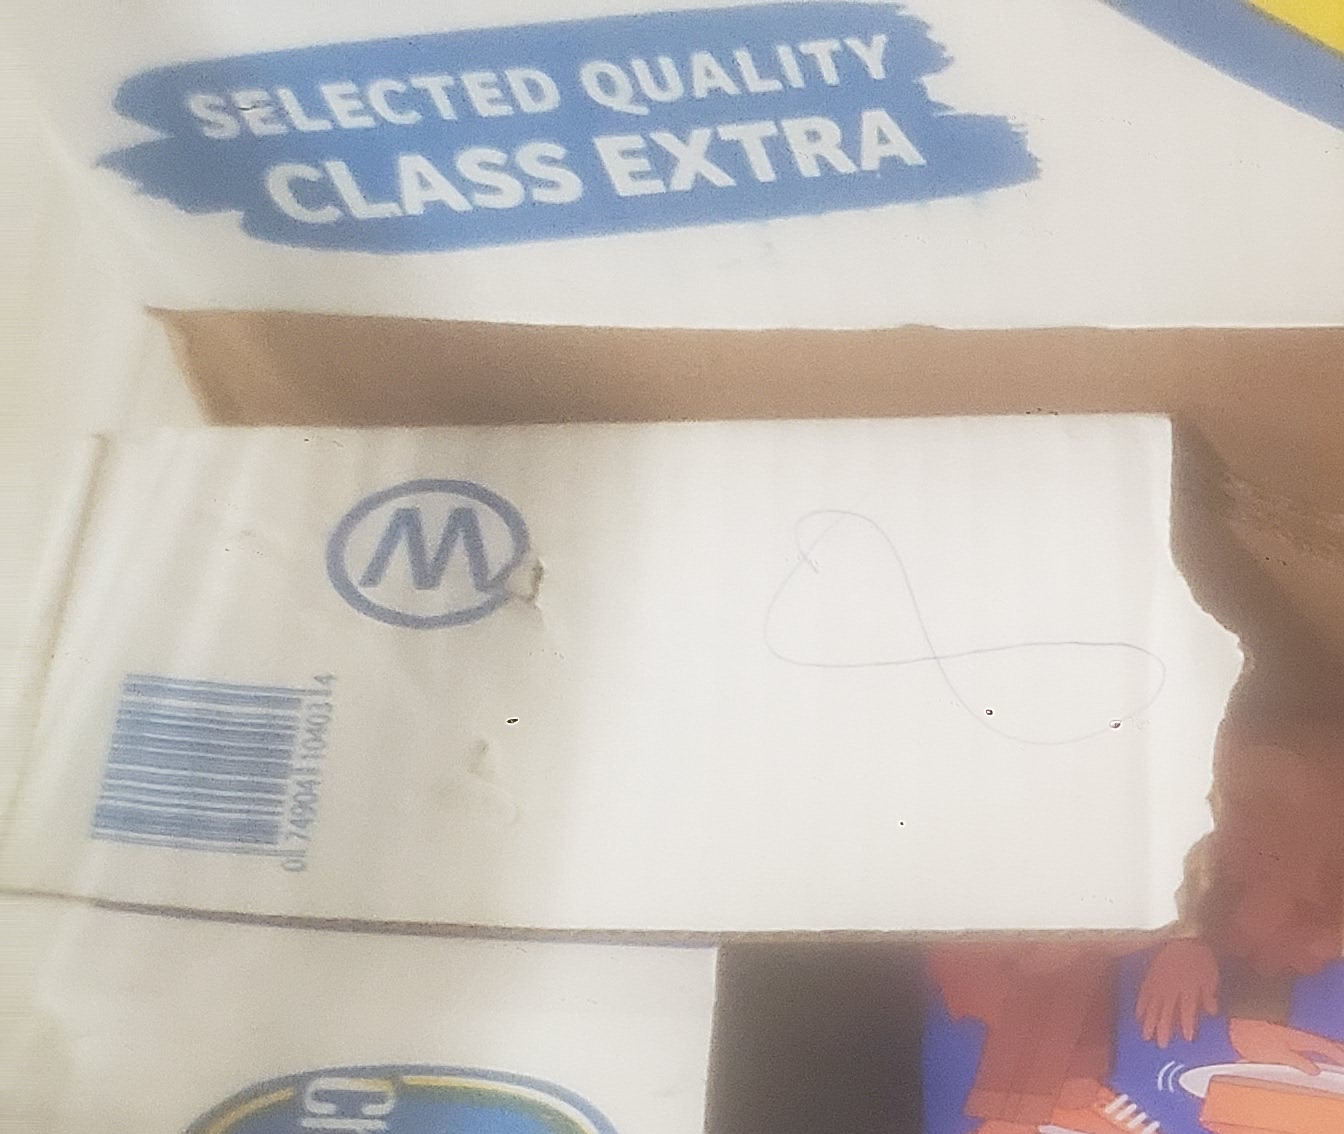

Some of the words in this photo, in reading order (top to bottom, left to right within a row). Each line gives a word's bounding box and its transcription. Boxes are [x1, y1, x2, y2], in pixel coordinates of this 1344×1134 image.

[187, 67, 558, 142] SELECTED
[582, 33, 889, 119] QUALITY
[262, 142, 586, 226] CLASS
[594, 109, 928, 198] EXTRA
